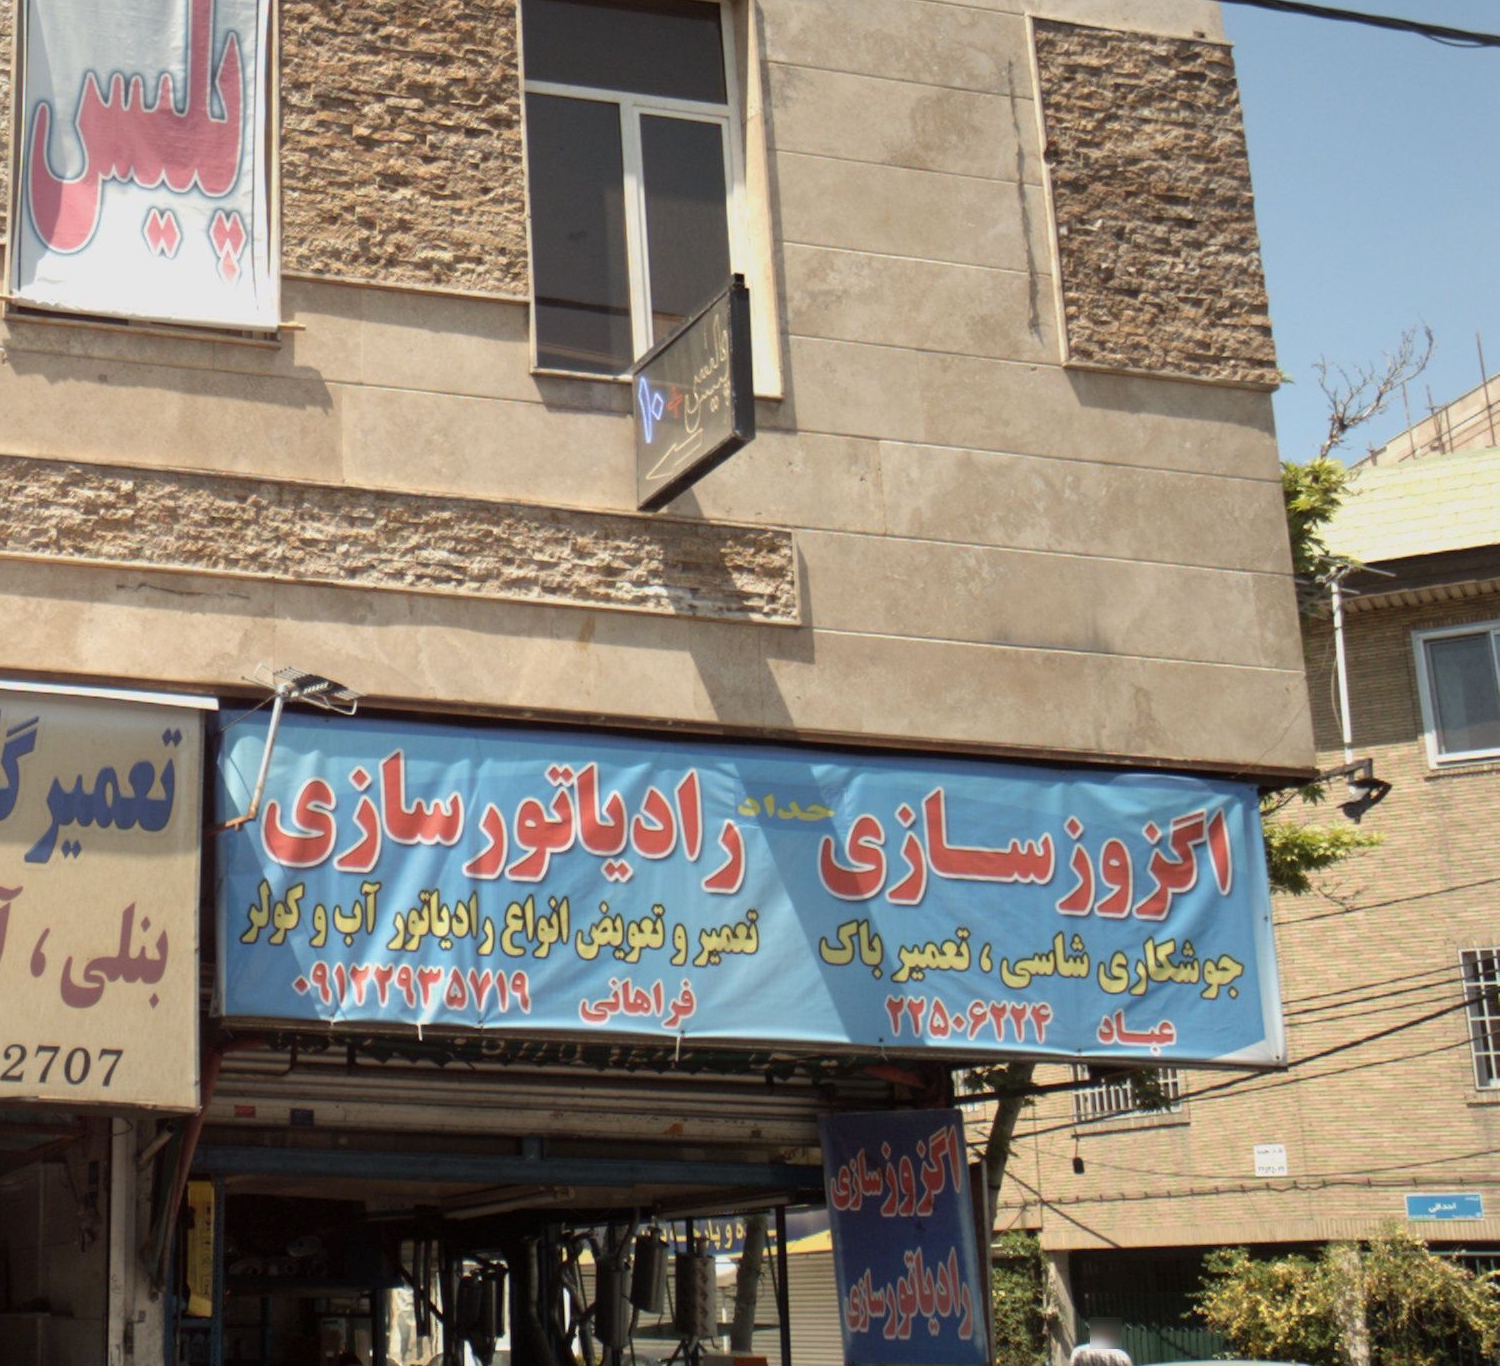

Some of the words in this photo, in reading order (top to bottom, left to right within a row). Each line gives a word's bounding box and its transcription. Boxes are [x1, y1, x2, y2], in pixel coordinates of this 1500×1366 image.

[240, 880, 304, 945] کولر
[310, 902, 327, 947] و
[333, 881, 381, 946] آب
[387, 889, 494, 955] رادیاتور
[500, 895, 570, 958] انواع
[575, 900, 665, 963] تعویض
[693, 910, 760, 966] تعمیر
[670, 924, 688, 965] و
[819, 920, 884, 979] باک
[892, 929, 971, 982] تعمیر
[1097, 937, 1244, 999] جوشکاری
[580, 978, 696, 1028] فراهانی
[1098, 1010, 1177, 1056] عباد
